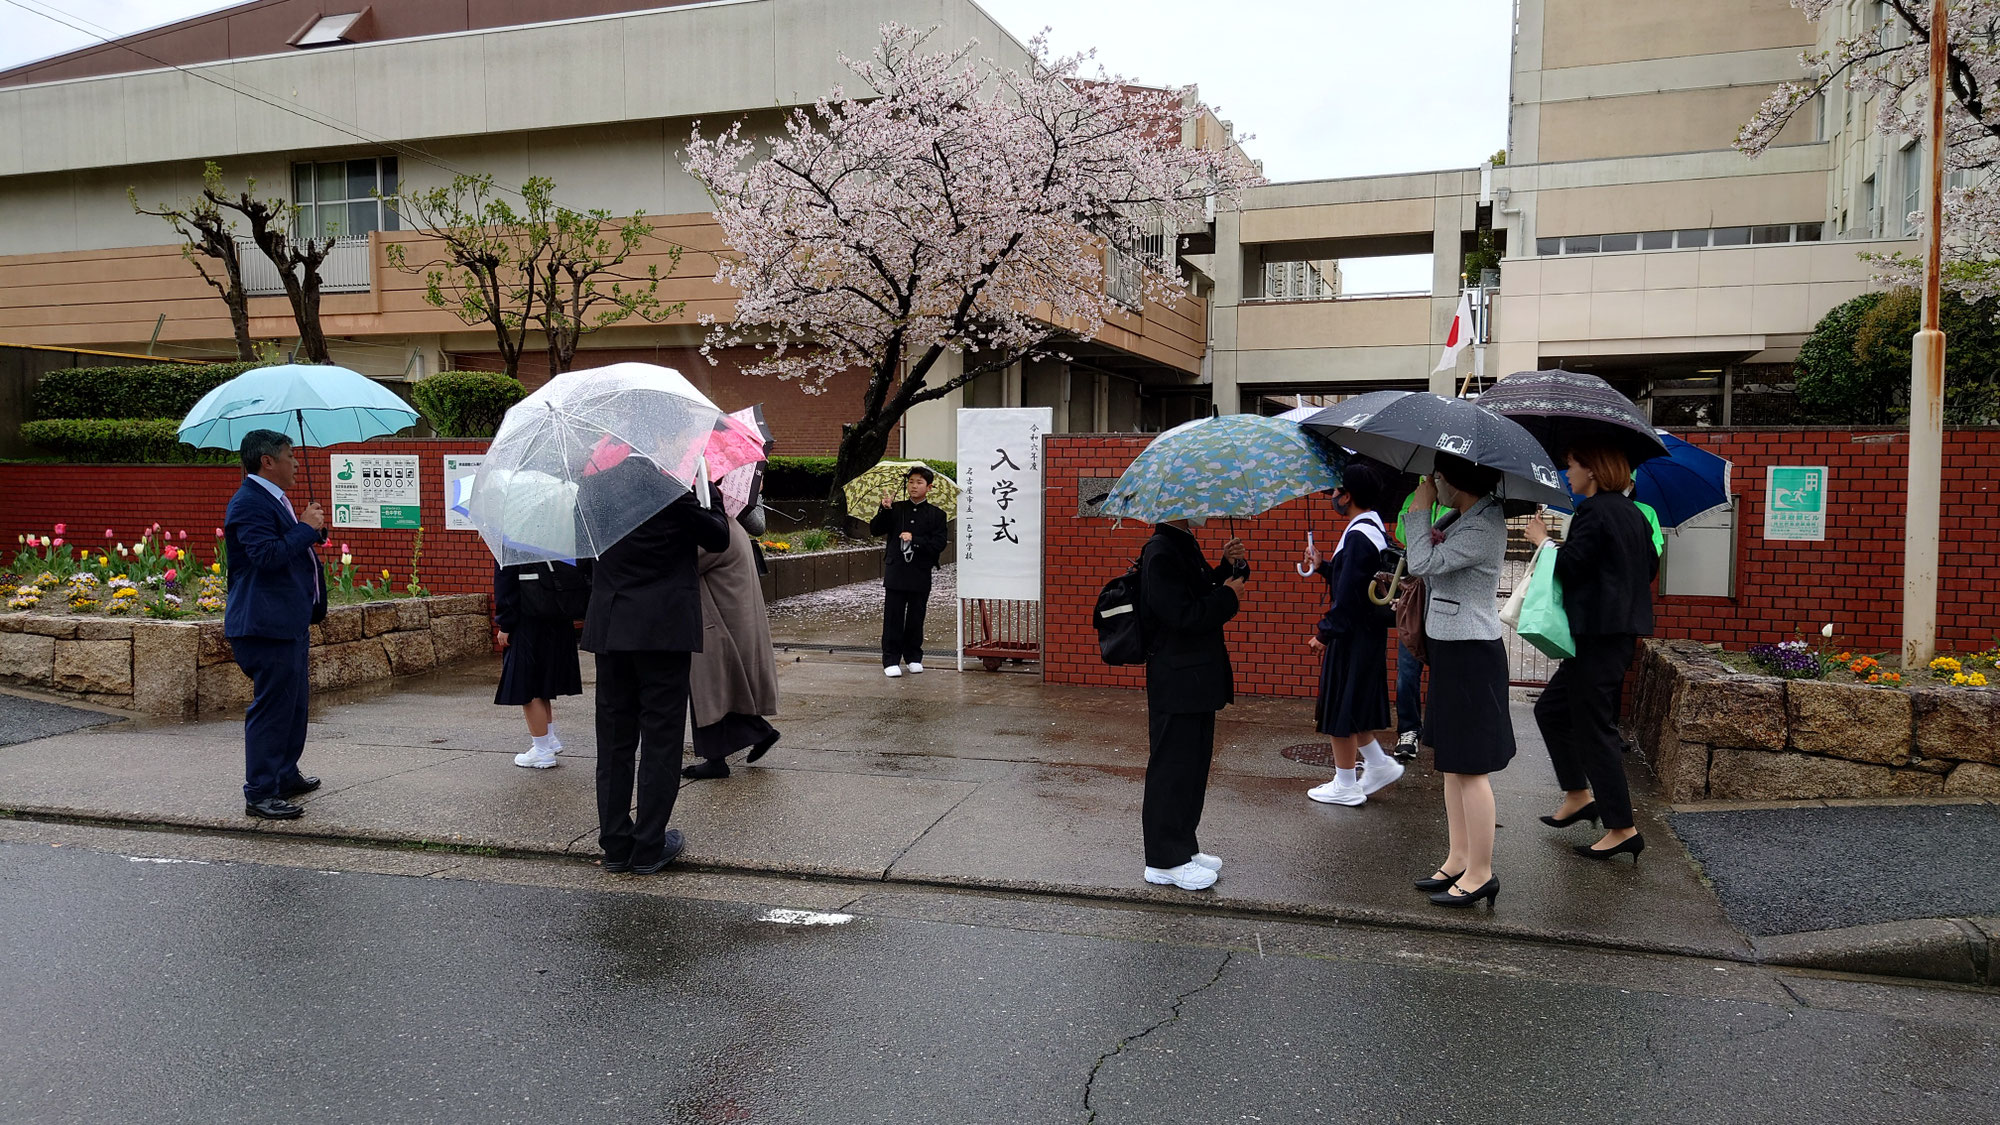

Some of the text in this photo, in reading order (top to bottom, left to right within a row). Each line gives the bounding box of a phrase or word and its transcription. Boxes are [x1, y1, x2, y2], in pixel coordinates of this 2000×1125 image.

[1029, 424, 1039, 471] 令和六年度
[965, 466, 974, 561] 名古屋市立一色中学校
[990, 448, 1020, 545] 入学式
